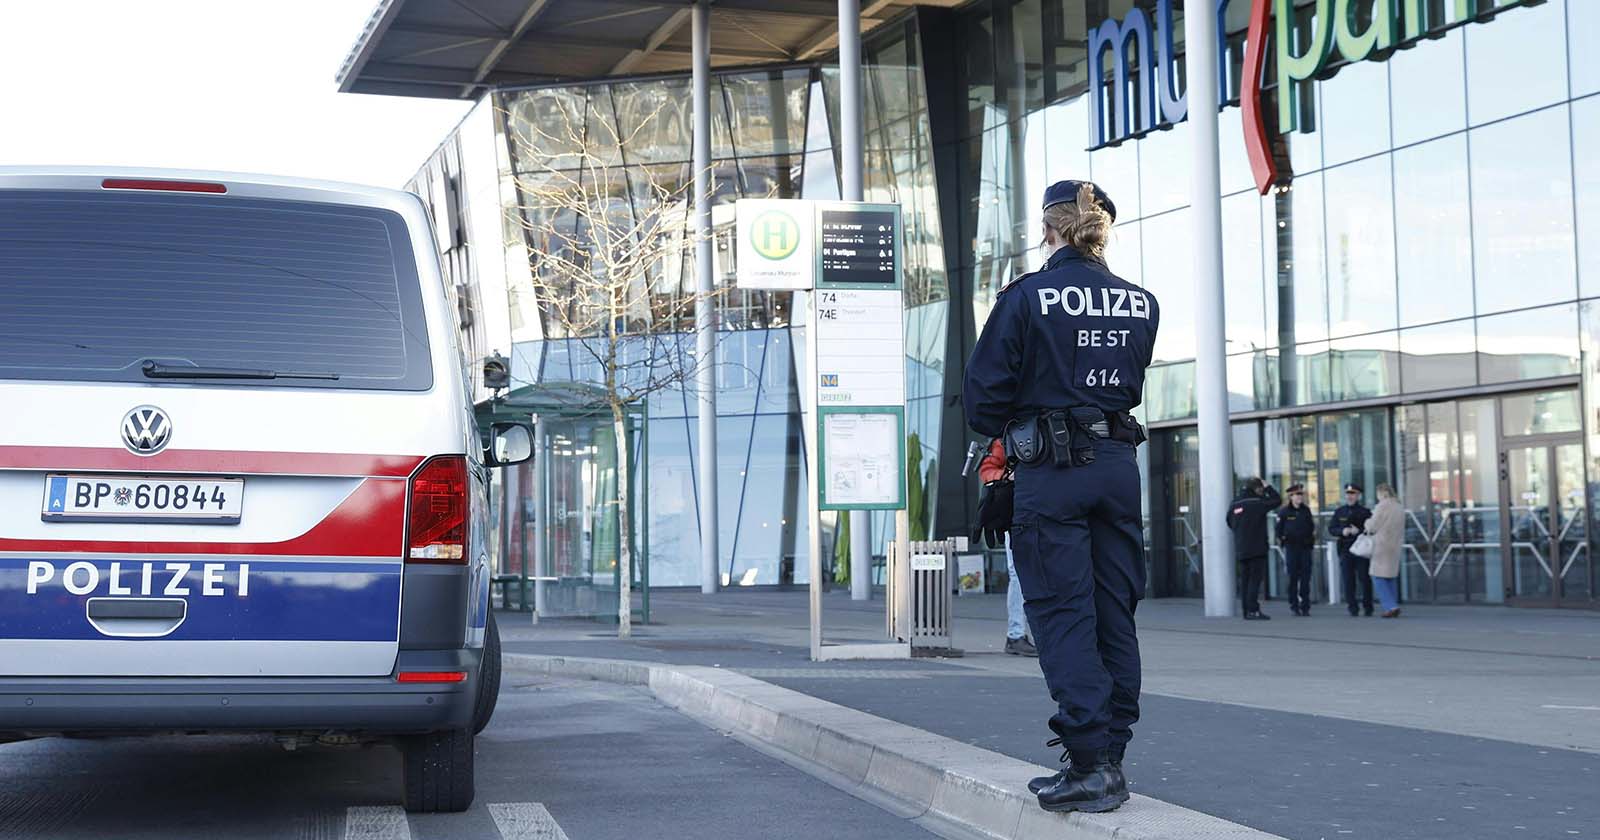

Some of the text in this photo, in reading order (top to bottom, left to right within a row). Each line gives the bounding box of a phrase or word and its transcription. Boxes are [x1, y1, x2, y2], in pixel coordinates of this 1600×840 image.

[763, 221, 787, 249] H
[821, 292, 836, 303] 74
[1037, 285, 1151, 321] POLIZEI
[818, 309, 837, 320] 74E
[1077, 330, 1131, 347] BE ST
[822, 375, 837, 386] N4
[1085, 368, 1121, 387] 614
[53, 499, 61, 508] A
[74, 482, 227, 511] BP 60844
[26, 560, 250, 597] POLIZEI
